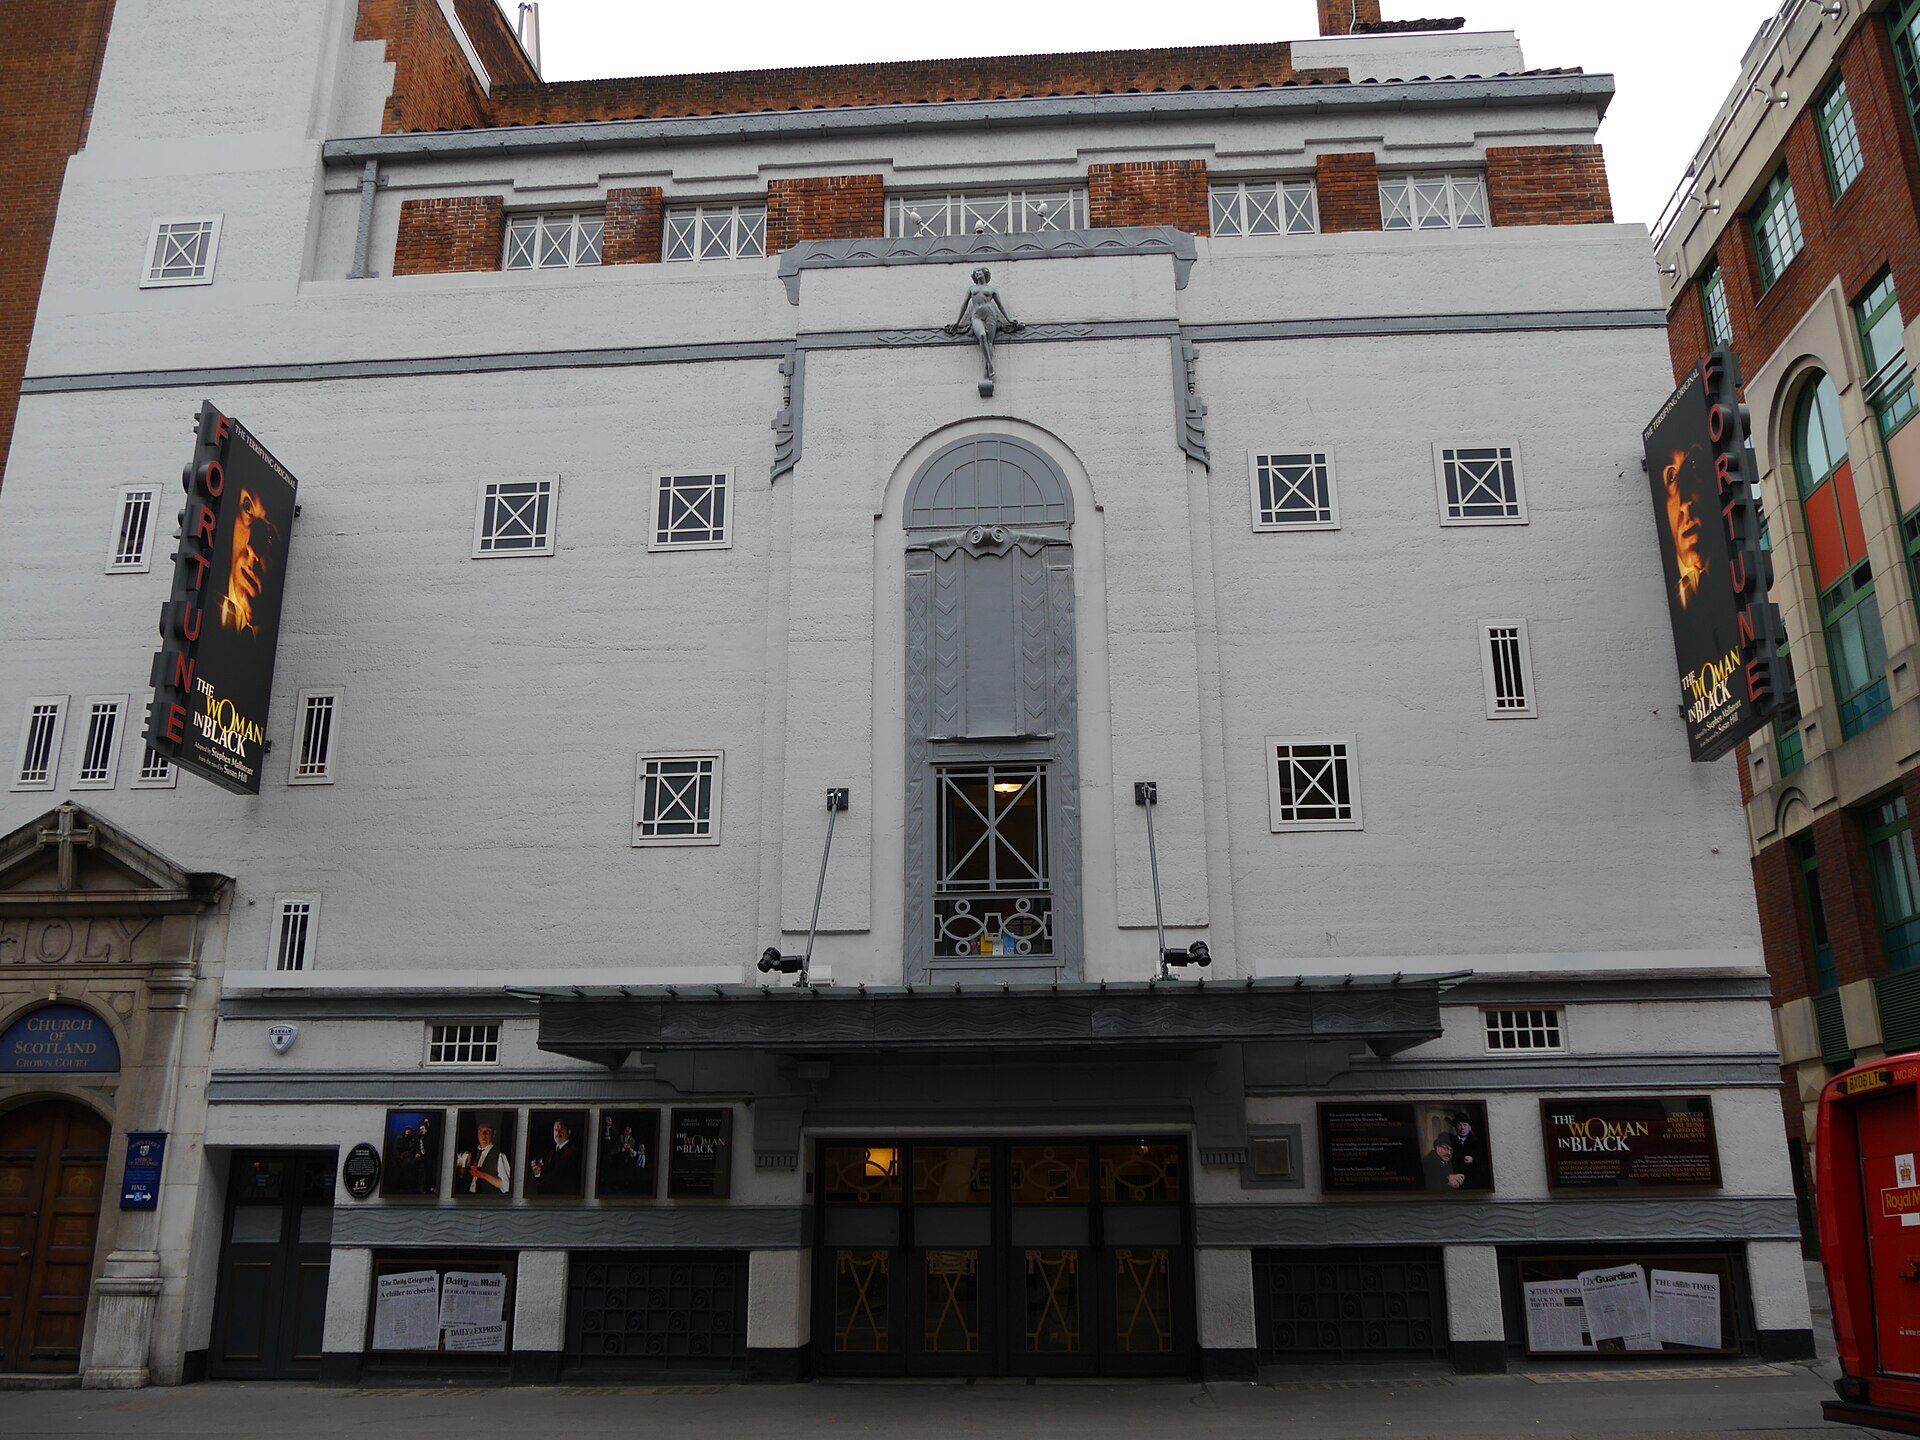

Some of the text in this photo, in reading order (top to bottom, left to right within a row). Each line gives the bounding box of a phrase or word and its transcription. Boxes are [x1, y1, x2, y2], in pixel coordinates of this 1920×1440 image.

[1700, 353, 1763, 702] FORTUNE
[166, 415, 232, 745] FORTUNE
[1681, 670, 1696, 691] THE
[1691, 645, 1741, 701] WOMAN
[196, 677, 215, 698] THE
[1687, 677, 1732, 723] IN BLACK
[206, 698, 264, 746] WOMAN
[193, 711, 246, 758] IN BLACK
[27, 1018, 94, 1031] CHURCH
[50, 1032, 65, 1041] OF
[14, 1041, 97, 1054] SCOTLAND
[16, 1058, 89, 1068] CROWN COURT
[1552, 1115, 1575, 1124] THE
[1568, 1117, 1649, 1141] WOMAN
[683, 1144, 714, 1153] BLACK
[684, 1135, 727, 1147] WOMAN
[1558, 1136, 1631, 1151] IN BLACK
[1886, 1191, 1911, 1211] Royal
[446, 1277, 500, 1288] Daily Mail
[1581, 1277, 1594, 1287] The
[1594, 1271, 1638, 1284] Guardian
[1691, 1282, 1716, 1291] TIMES
[413, 1287, 436, 1295] cherish
[451, 1325, 502, 1336] DAILY EXPRESS
